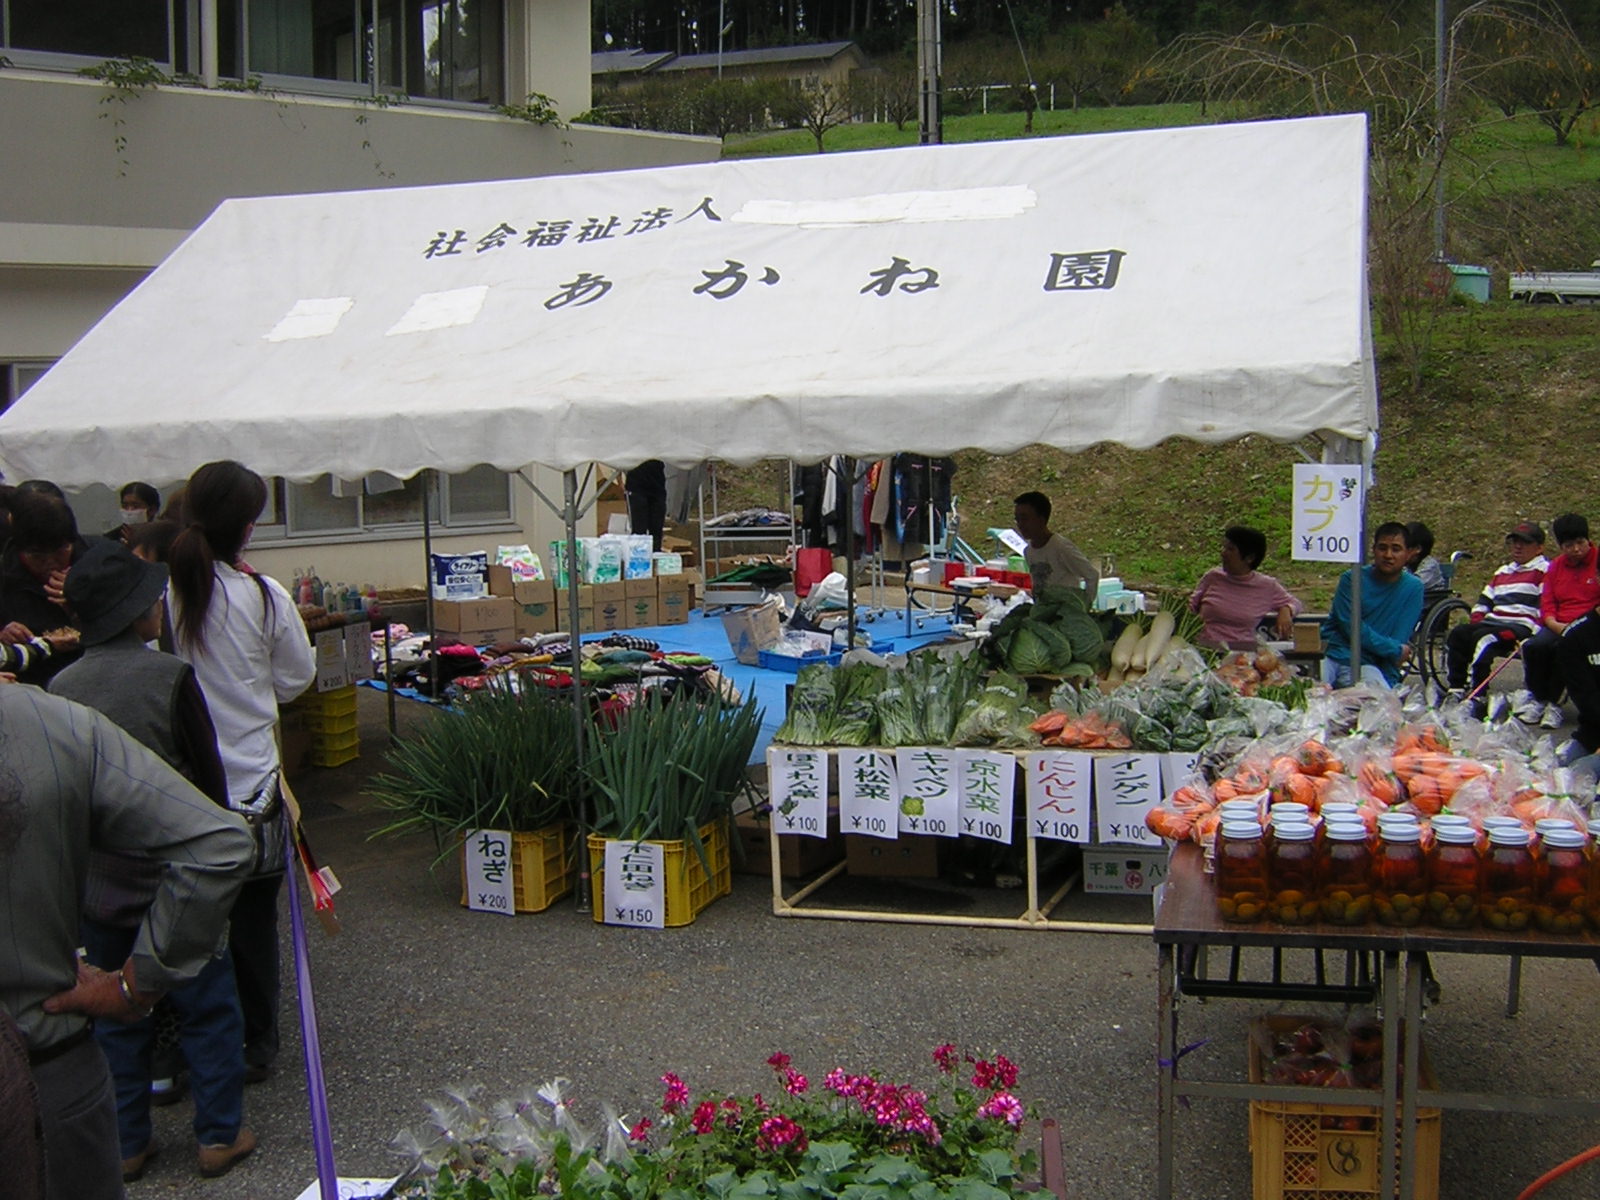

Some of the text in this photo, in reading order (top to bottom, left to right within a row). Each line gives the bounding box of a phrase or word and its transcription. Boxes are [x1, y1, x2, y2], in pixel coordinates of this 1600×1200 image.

[421, 196, 722, 259] 社会福祉法人
[543, 249, 1126, 311] あかね園
[1302, 474, 1338, 532] カブ
[1301, 535, 1350, 553] ¥100
[787, 752, 820, 799] ほうれん草
[853, 753, 890, 801] 小松菜
[911, 752, 949, 798] キャベツ
[965, 759, 1002, 814] 京水菜
[1038, 760, 1077, 814] にんじん
[1111, 757, 1150, 805] インゲン
[785, 815, 818, 832] ¥100
[851, 815, 886, 833] ¥100
[909, 817, 946, 834] ¥100
[963, 817, 1002, 839] ¥100
[1036, 819, 1079, 840] ¥100
[478, 834, 508, 883] ねぎ
[1089, 862, 1119, 877] 千葉
[477, 892, 508, 909] ¥200
[615, 907, 653, 923] ¥150
